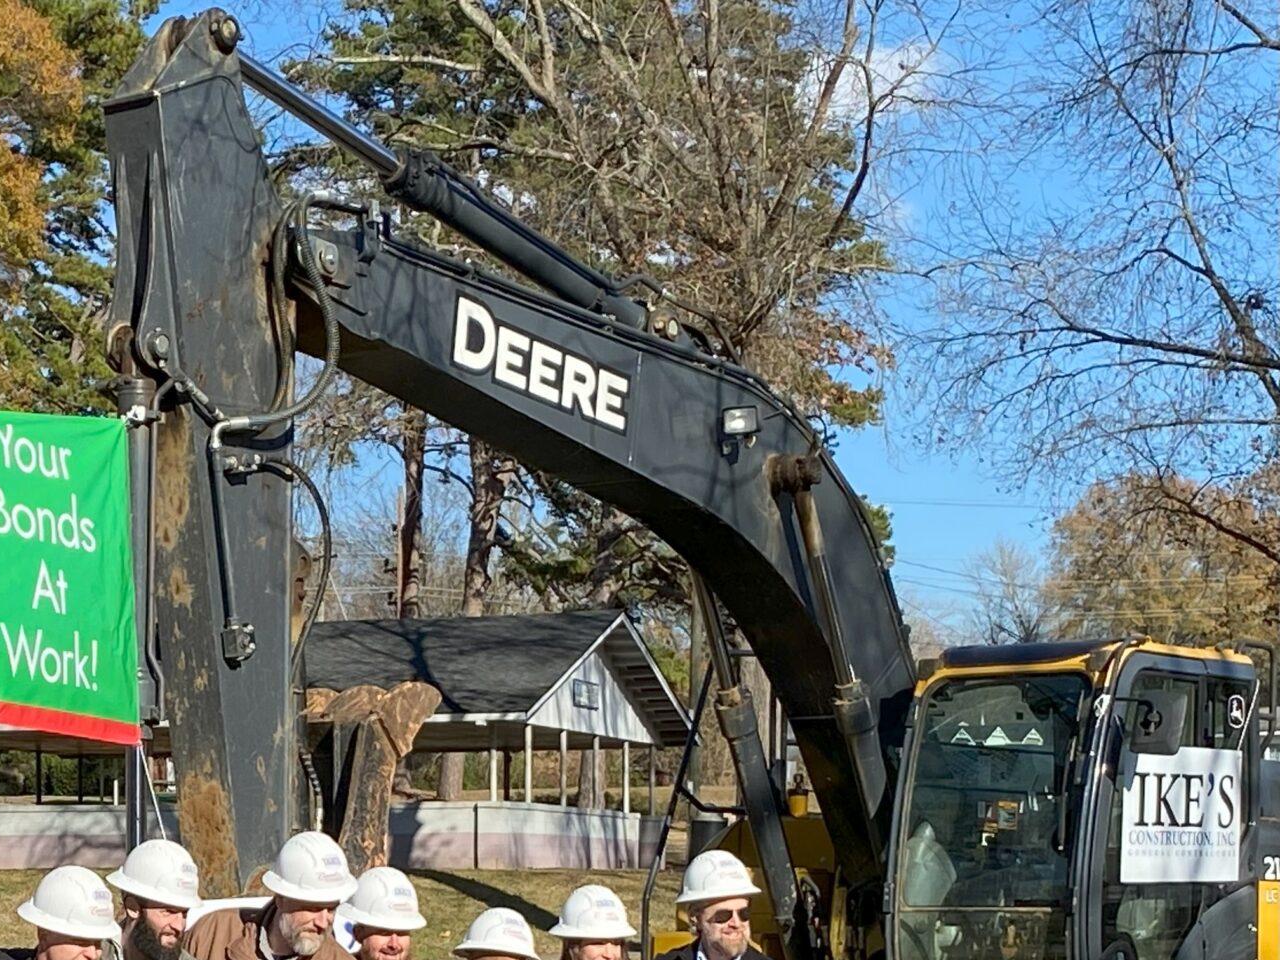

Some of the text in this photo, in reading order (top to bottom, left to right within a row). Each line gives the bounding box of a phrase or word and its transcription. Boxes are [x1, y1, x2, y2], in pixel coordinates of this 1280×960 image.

[453, 296, 628, 430] DEERE
[32, 558, 68, 615] At
[0, 622, 98, 691] Work!
[1133, 772, 1235, 829] IKE'S
